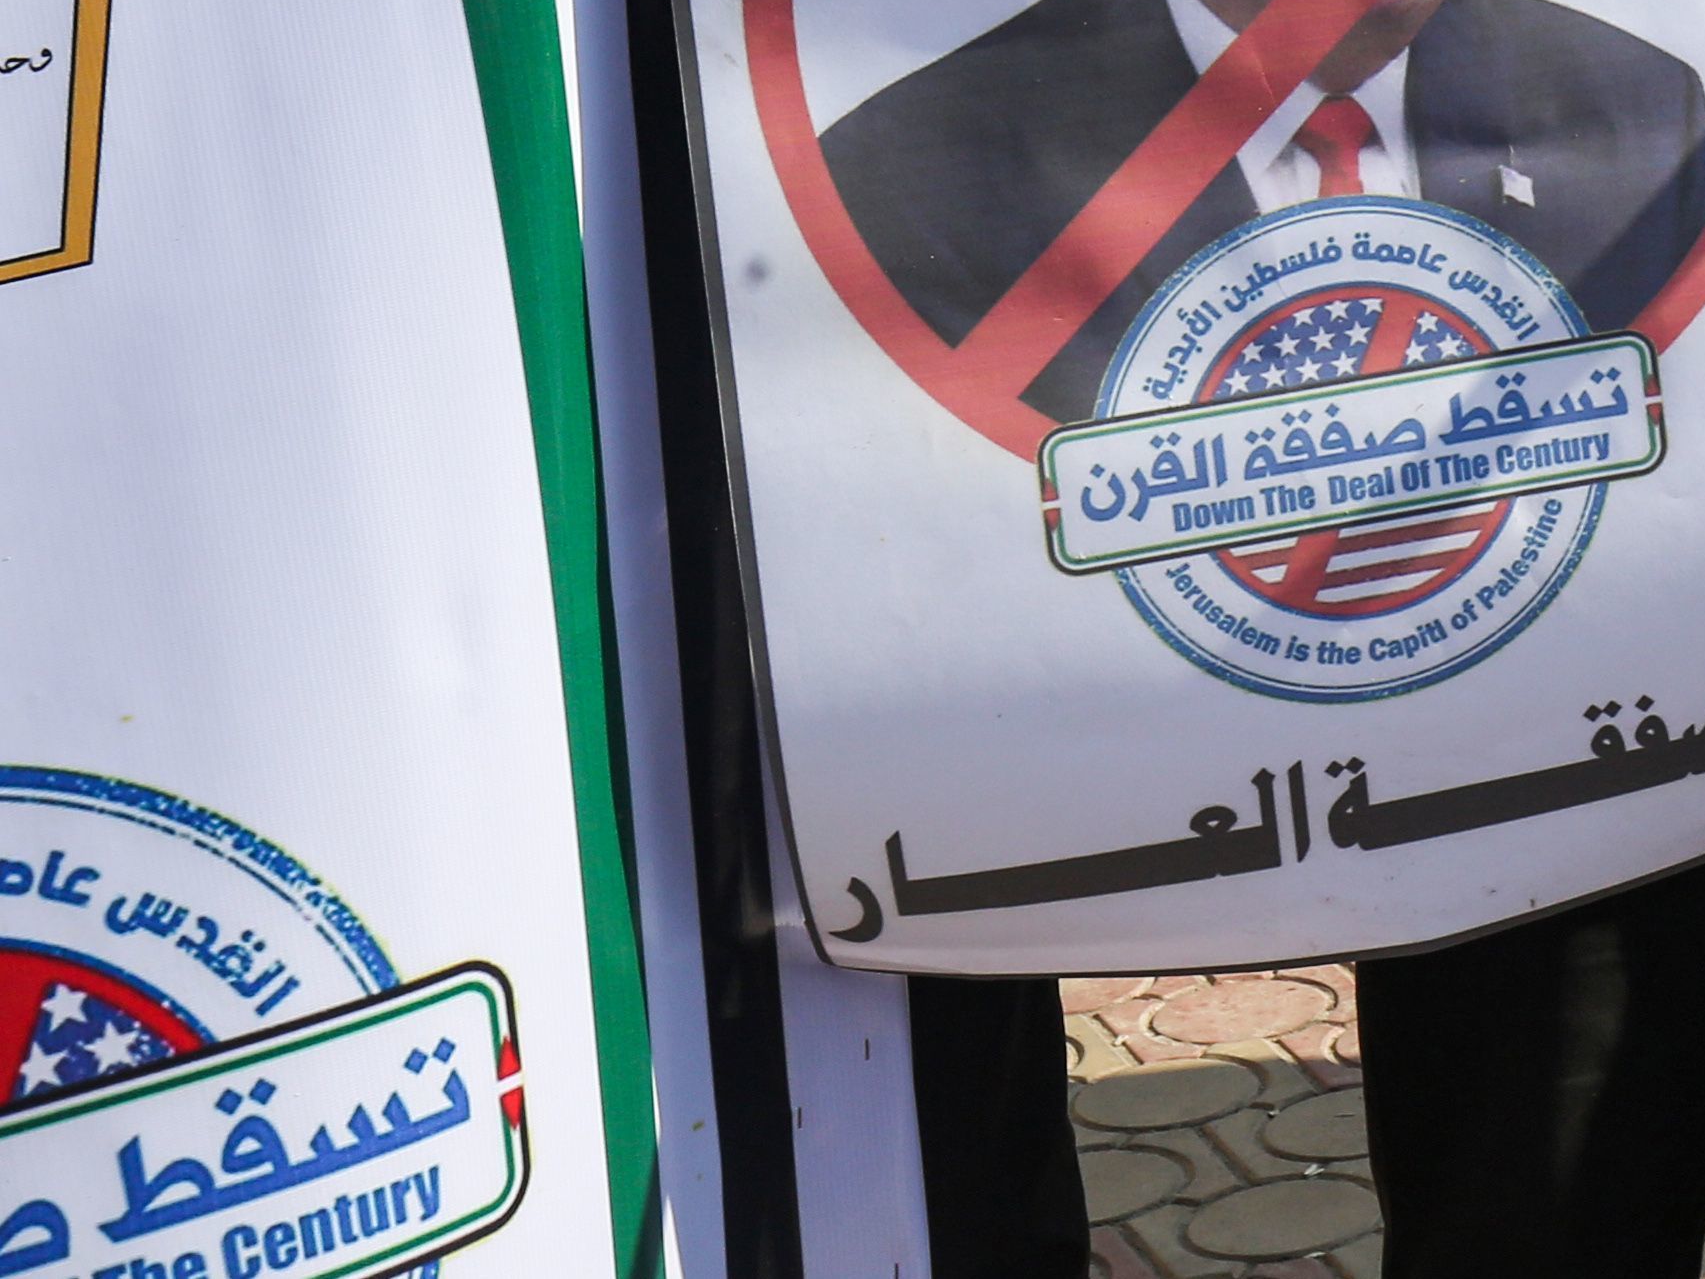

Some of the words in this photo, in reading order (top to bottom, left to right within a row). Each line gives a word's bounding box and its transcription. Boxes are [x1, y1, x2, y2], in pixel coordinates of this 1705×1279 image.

[1224, 236, 1343, 313] فلسطين
[1351, 232, 1448, 275] عاصمة
[1448, 268, 1542, 340] القدس
[1142, 298, 1223, 402] الأبدية
[1243, 402, 1427, 481] صفقة
[1437, 366, 1630, 445] تسقط
[1080, 431, 1228, 523] القرن
[1172, 494, 1256, 533] Down
[1259, 481, 1316, 517] The
[1329, 469, 1395, 506] Deal
[1401, 461, 1431, 493] Of
[1435, 452, 1490, 486] The
[1496, 430, 1611, 478] Century
[1165, 563, 1283, 658] Jerusalem
[1285, 635, 1310, 665] is
[1317, 639, 1362, 667] the
[1368, 619, 1448, 667] Capitl
[1451, 596, 1480, 635] of
[1479, 496, 1564, 614] Palestine
[828, 756, 1312, 944] العار
[105, 891, 301, 1018] القدس
[95, 1036, 472, 1244] تسقط
[221, 1164, 441, 1279] Century
